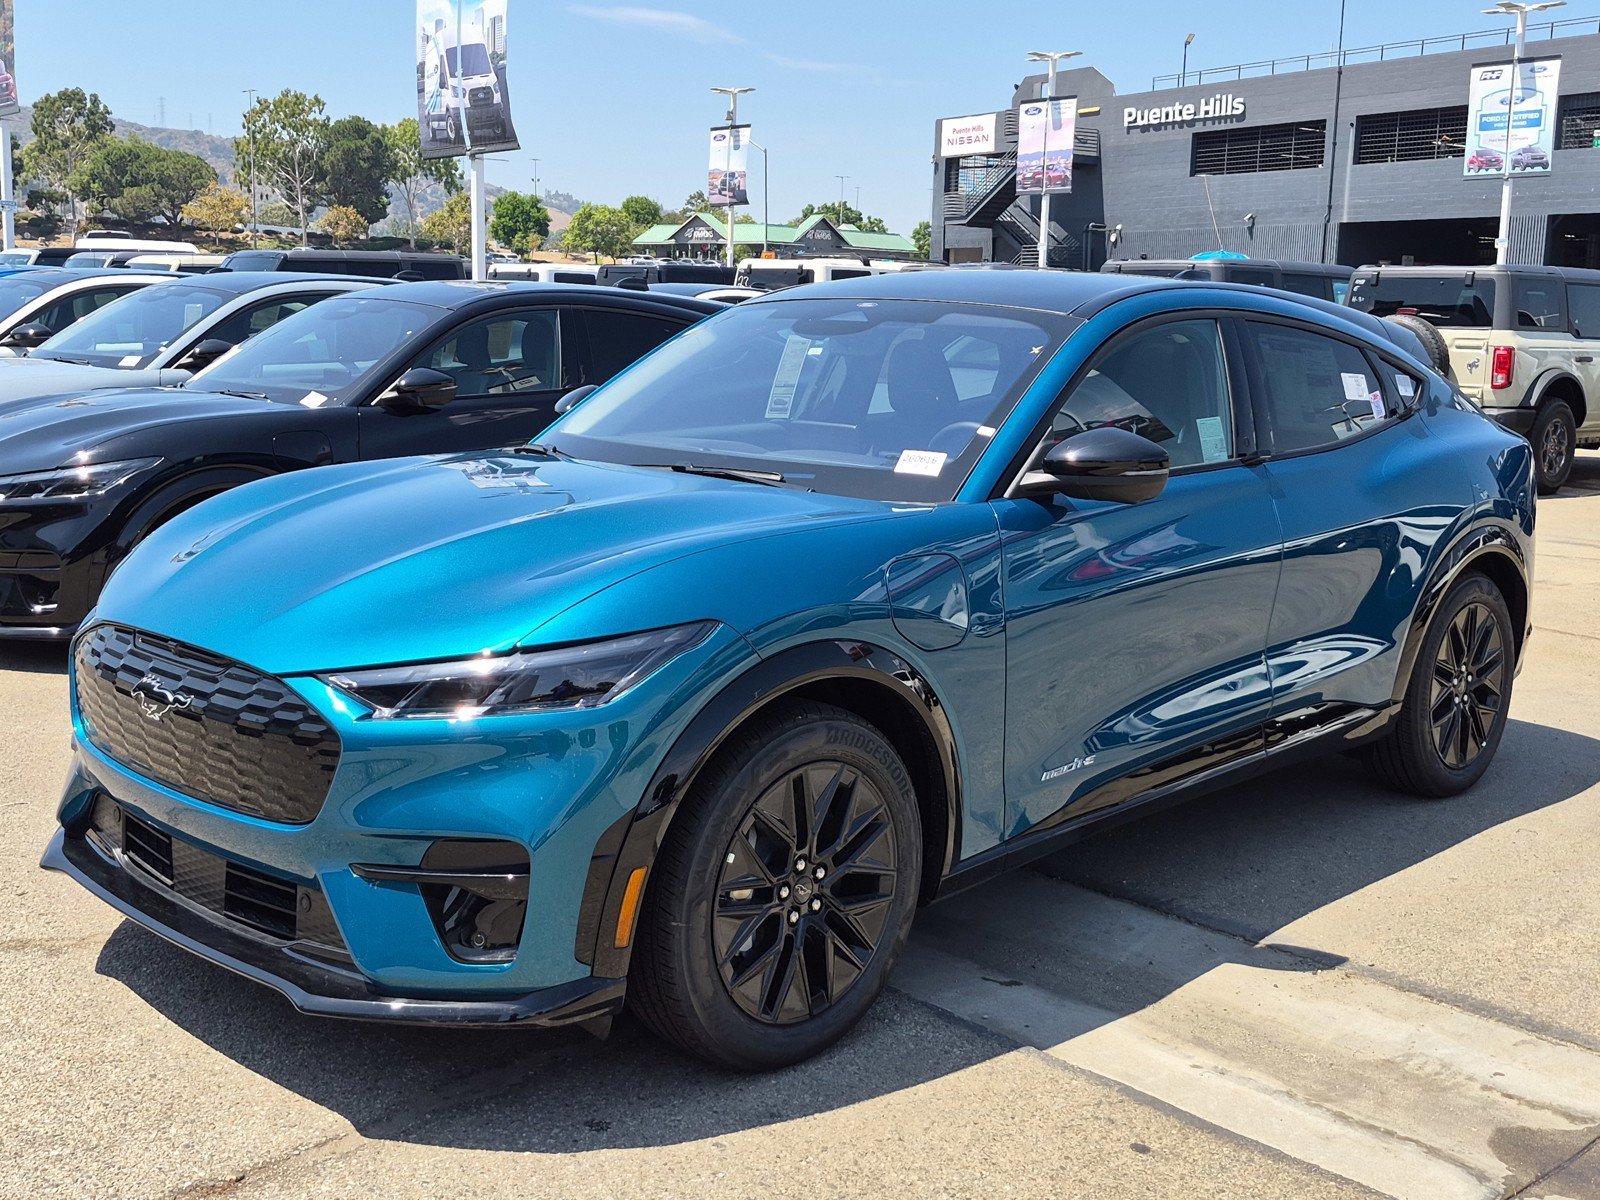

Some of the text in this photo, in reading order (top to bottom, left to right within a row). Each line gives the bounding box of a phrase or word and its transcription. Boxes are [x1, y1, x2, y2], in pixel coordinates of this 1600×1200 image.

[1123, 94, 1244, 127] Puente Hills
[947, 134, 989, 146] NISSAN
[952, 127, 971, 135] Puente
[825, 725, 912, 801] BRIDGESTONE
